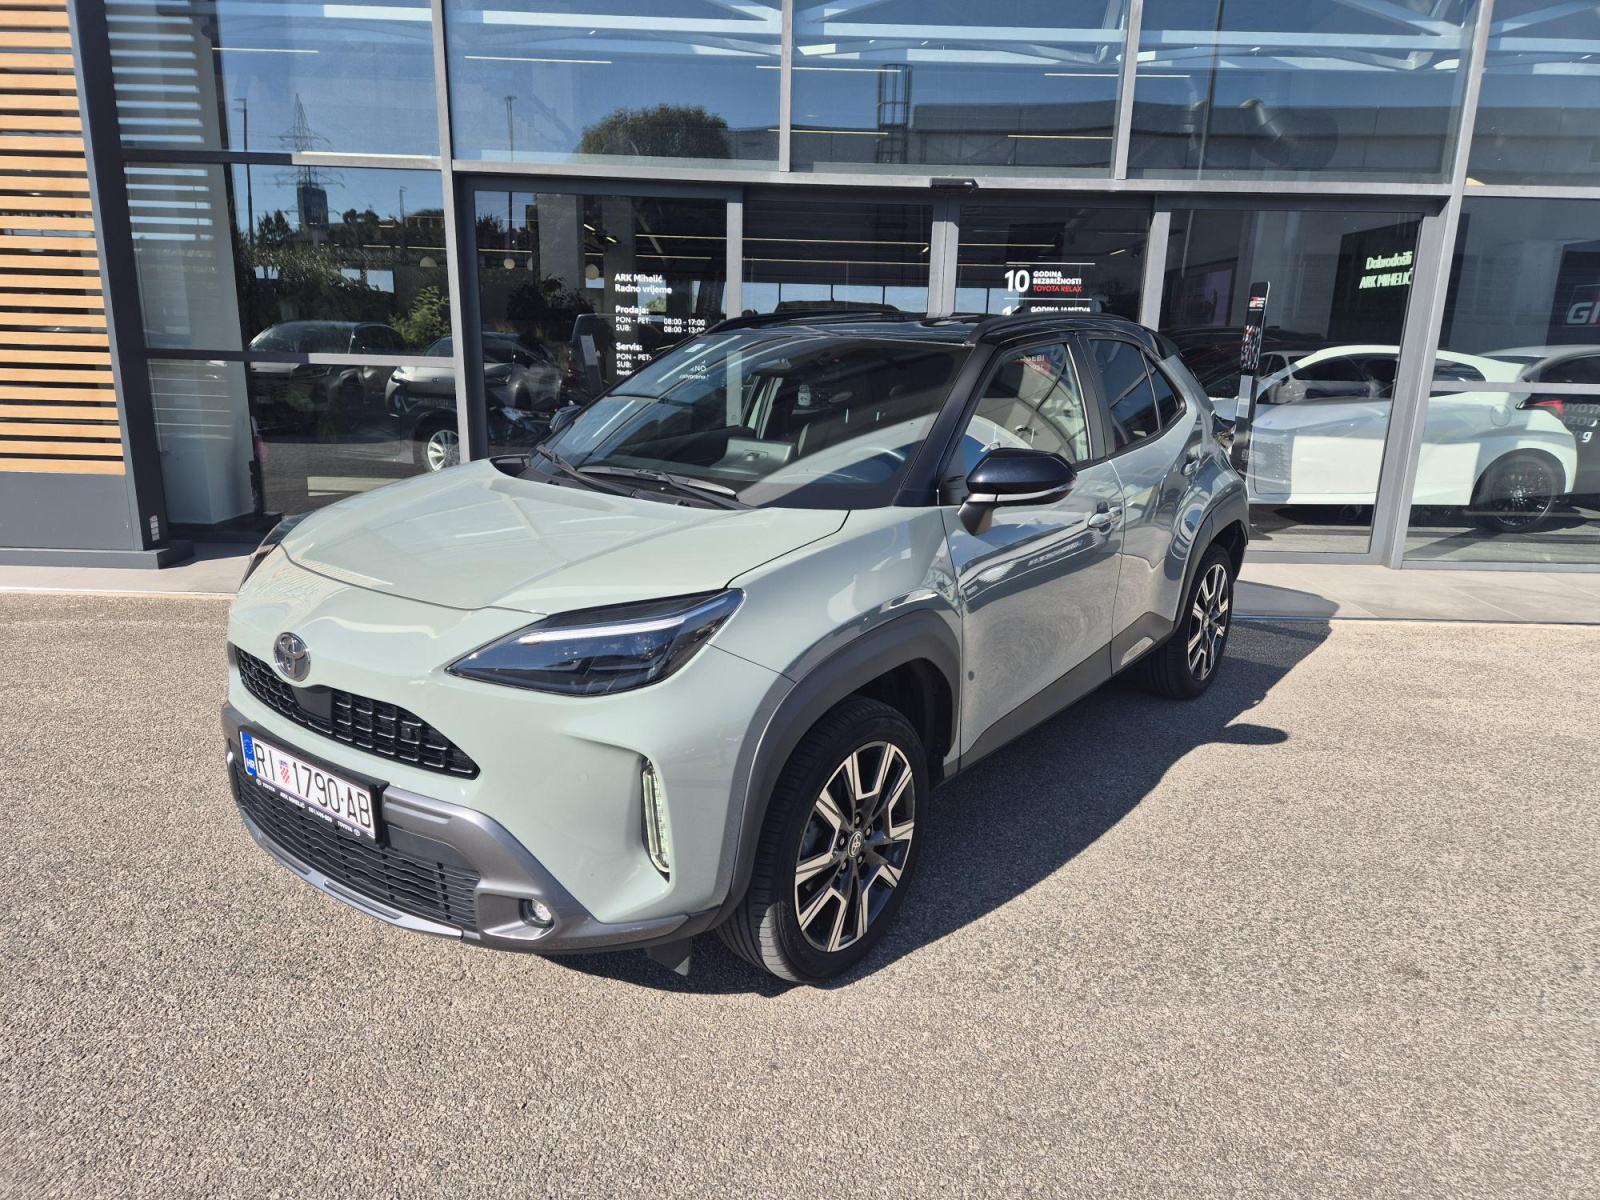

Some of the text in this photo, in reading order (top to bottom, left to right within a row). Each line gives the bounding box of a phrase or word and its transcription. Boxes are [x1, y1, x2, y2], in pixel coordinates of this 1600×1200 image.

[614, 273, 632, 282] ARK
[1004, 269, 1030, 293] 10
[1032, 277, 1082, 285] BEZBRIŽNOSTI
[614, 283, 673, 295] Radno vrijeme
[1061, 285, 1082, 293] RELAX
[615, 305, 650, 316] Prodaja:
[663, 317, 682, 325] 08:00
[687, 318, 706, 326] 17:00
[615, 324, 632, 332] SUB:
[663, 325, 682, 333] 08:00
[615, 342, 643, 351] Servis:
[615, 353, 632, 361] PON
[254, 743, 276, 782] RI
